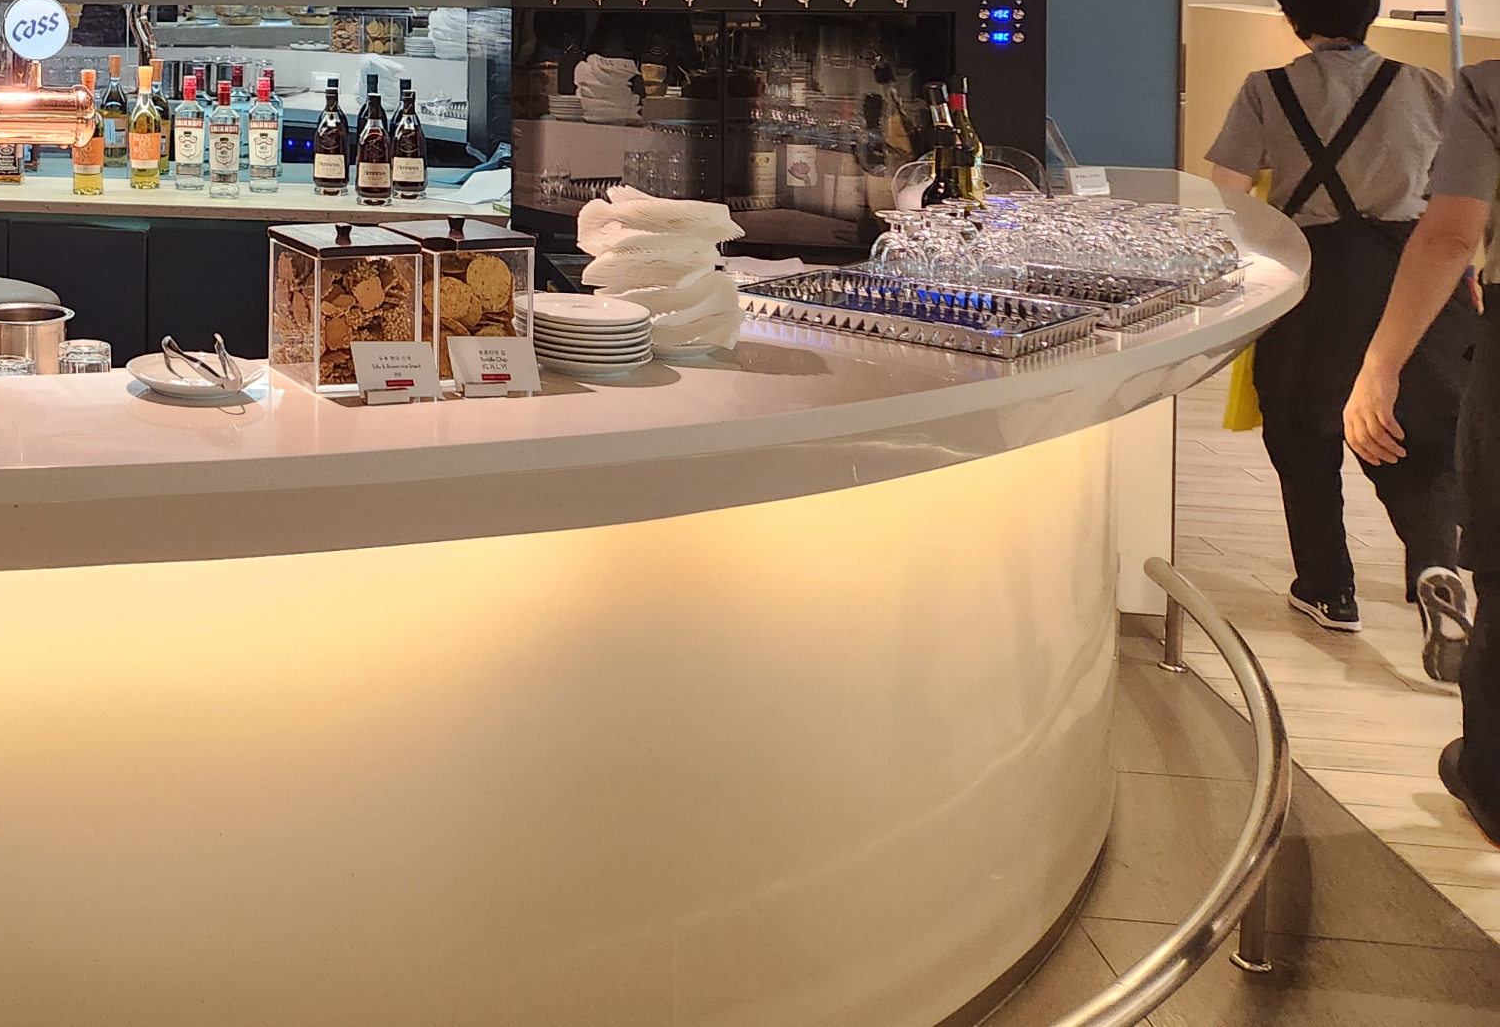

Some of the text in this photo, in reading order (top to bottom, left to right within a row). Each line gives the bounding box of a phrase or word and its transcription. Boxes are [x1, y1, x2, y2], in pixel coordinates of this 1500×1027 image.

[175, 119, 203, 127] SMIRNOFF
[250, 121, 278, 129] SMIRNOFF
[210, 125, 239, 133] SMIRNOFF
